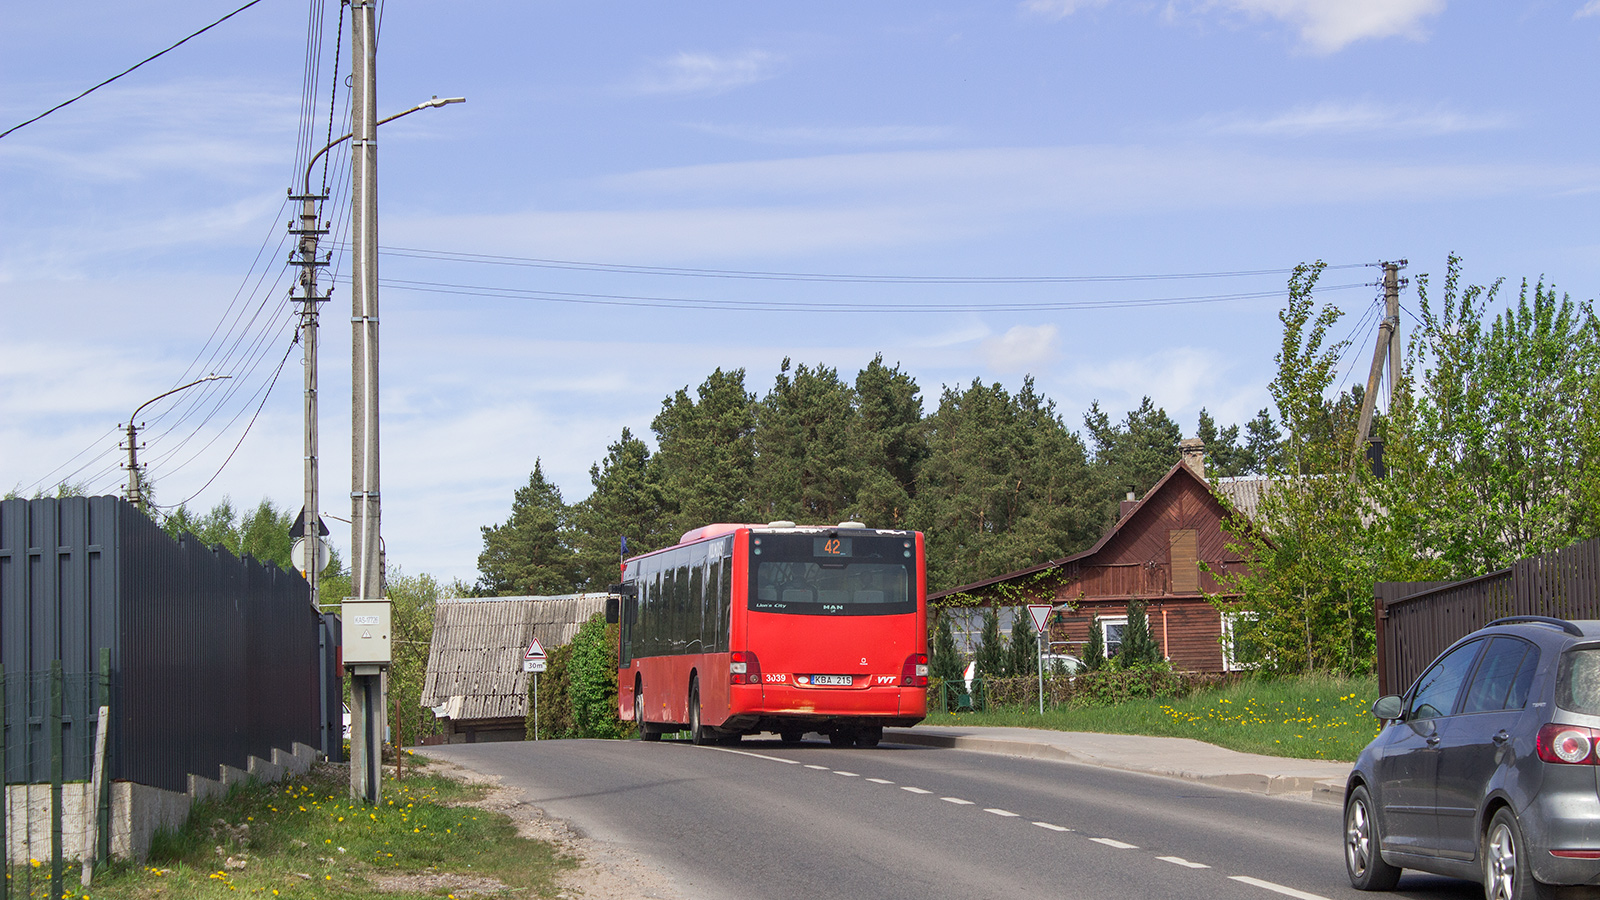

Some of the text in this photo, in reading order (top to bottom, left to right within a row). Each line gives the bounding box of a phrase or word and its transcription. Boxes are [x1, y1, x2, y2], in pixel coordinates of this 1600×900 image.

[824, 539, 840, 554] 42
[766, 674, 786, 682] 3039
[815, 676, 852, 685] KBA 215
